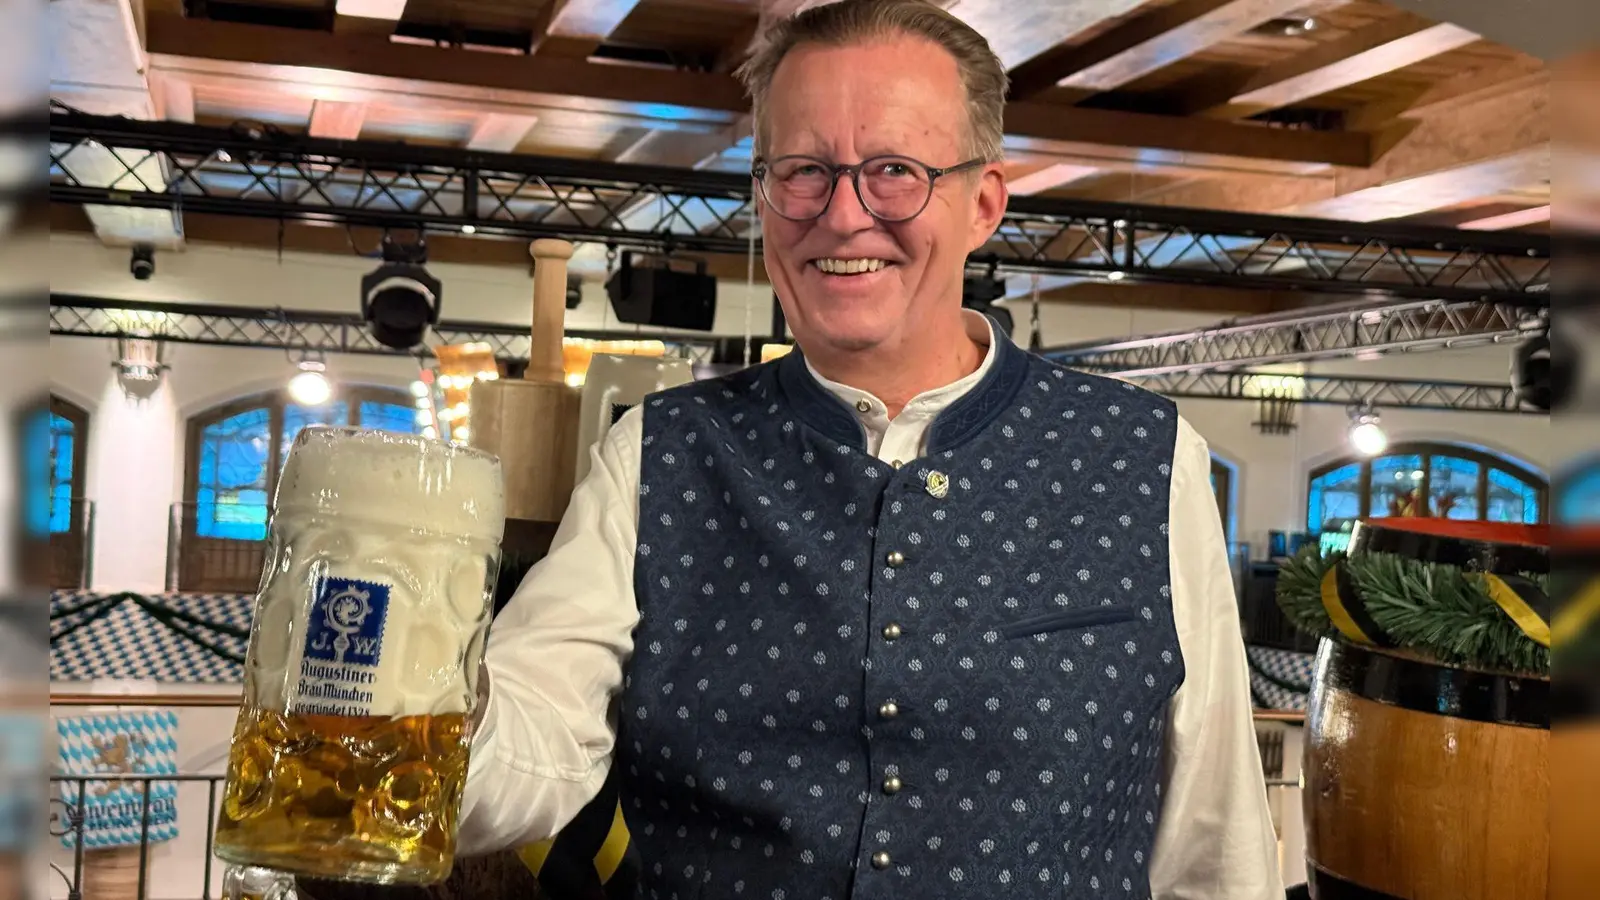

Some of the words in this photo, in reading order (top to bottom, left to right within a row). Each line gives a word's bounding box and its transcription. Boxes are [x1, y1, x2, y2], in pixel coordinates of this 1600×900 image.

[311, 631, 331, 651] J.
[351, 635, 376, 656] W.
[301, 660, 377, 684] Augustiner
